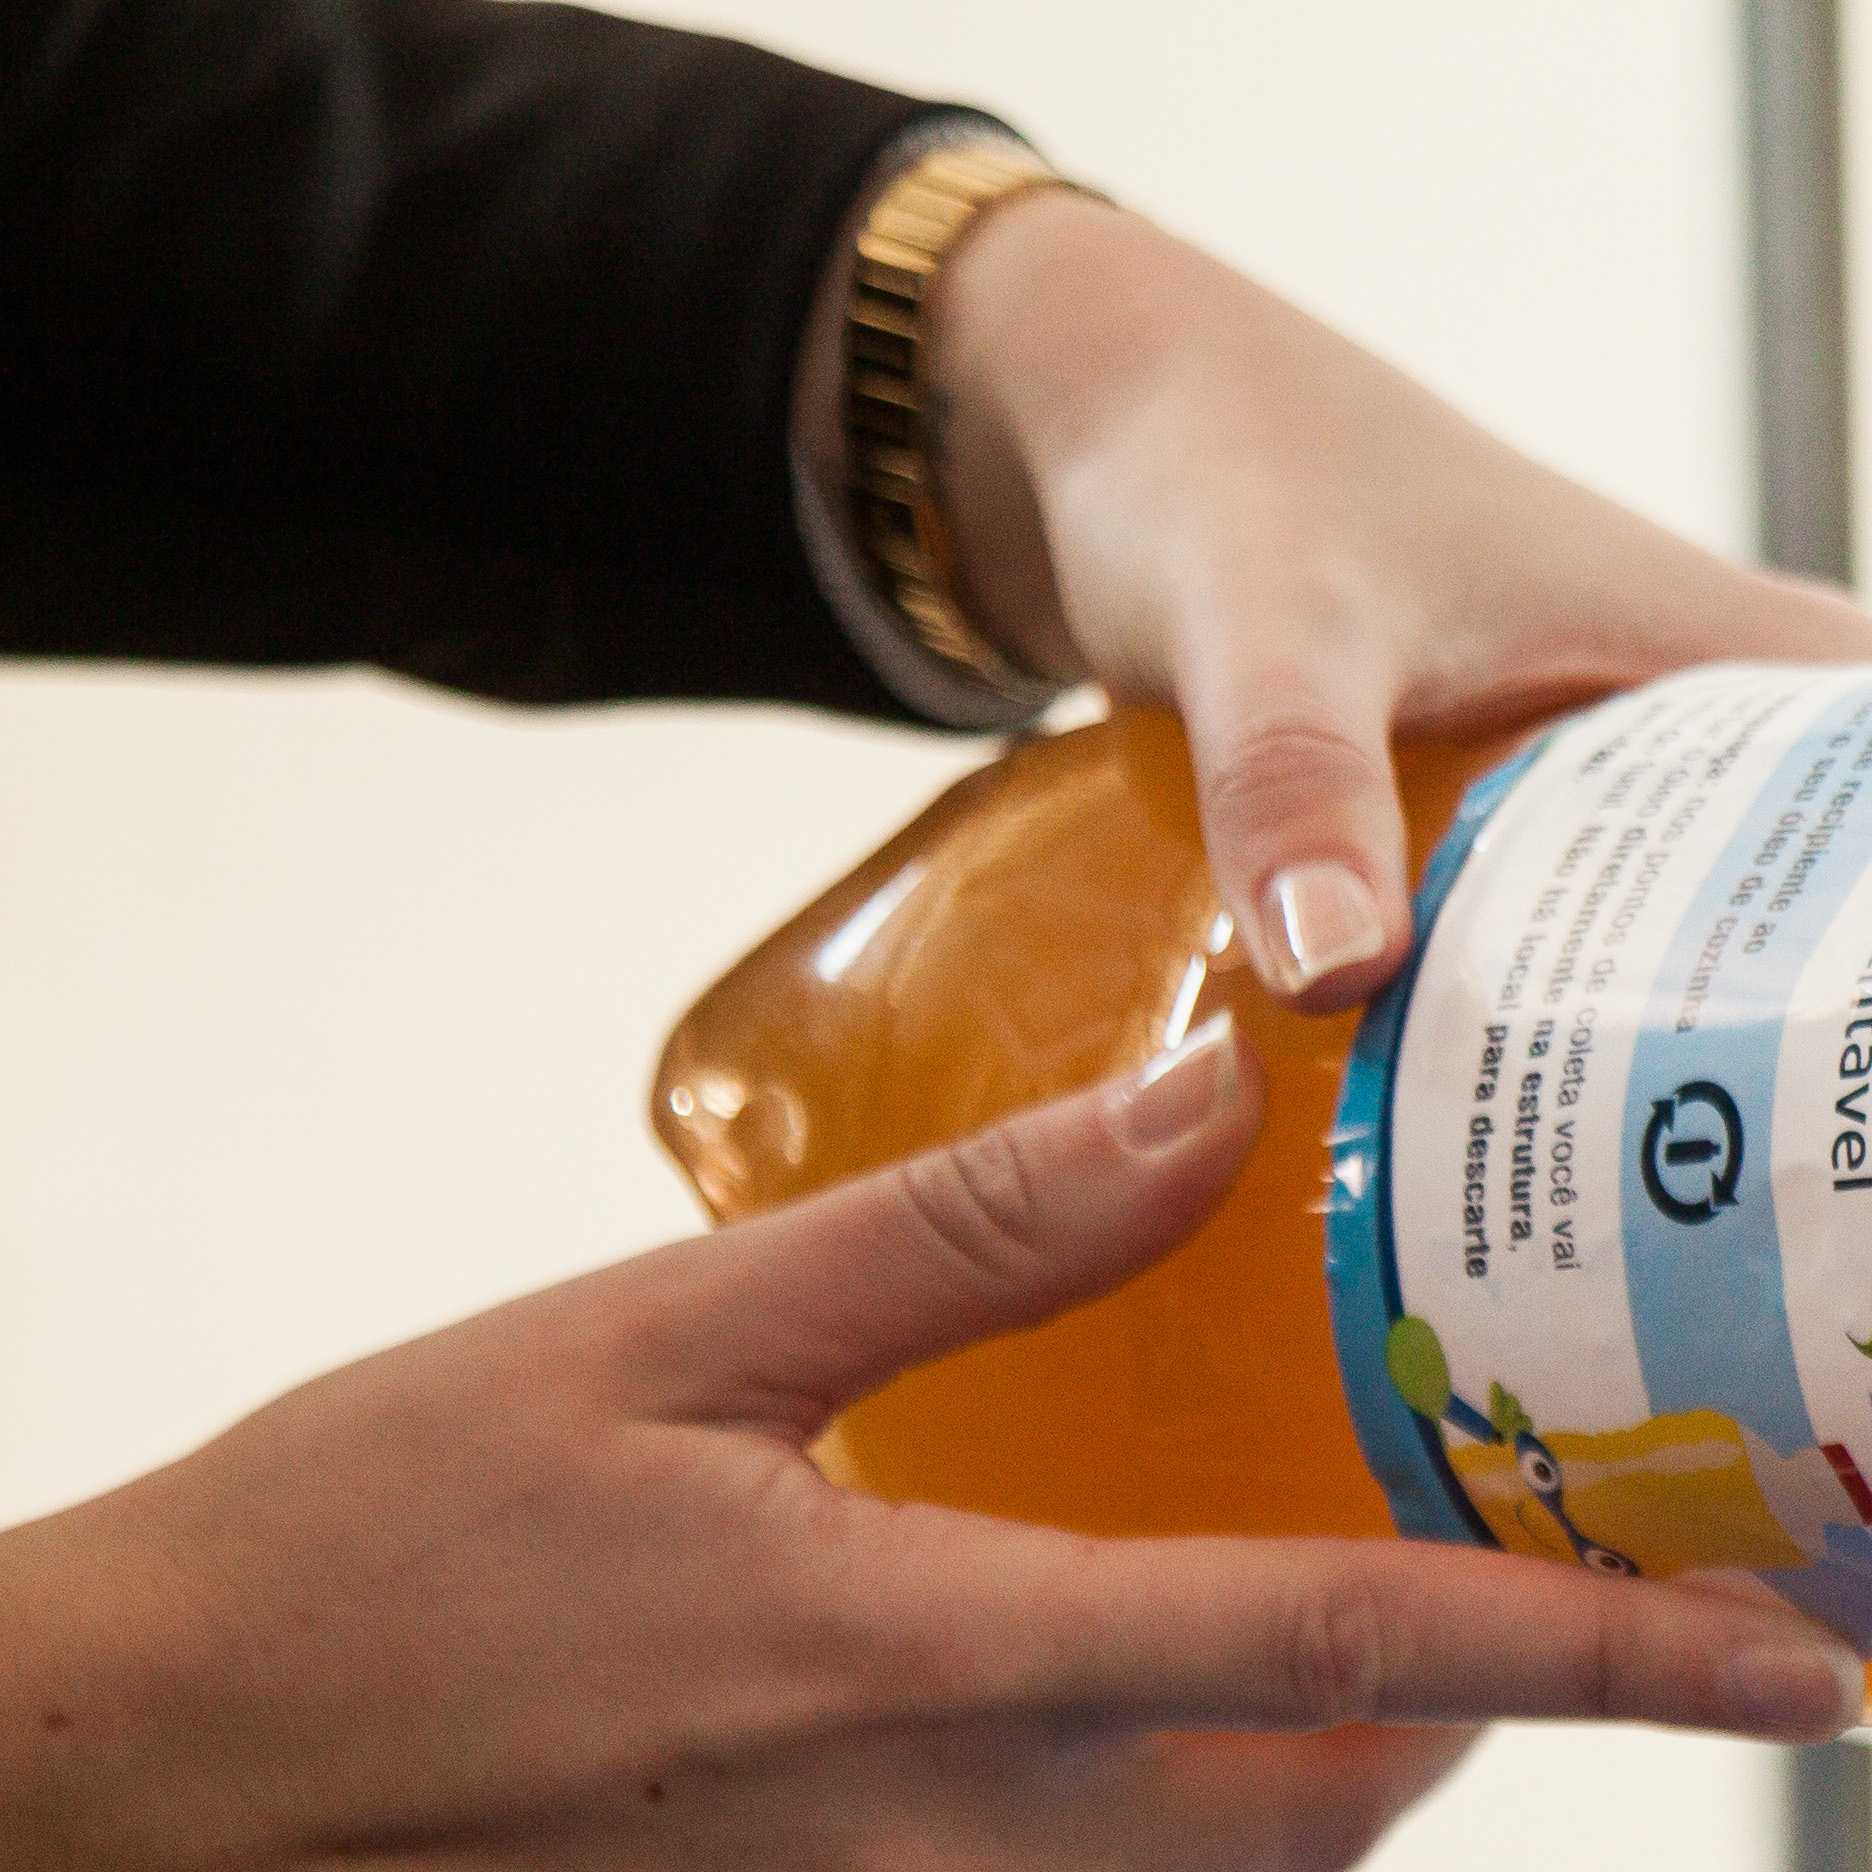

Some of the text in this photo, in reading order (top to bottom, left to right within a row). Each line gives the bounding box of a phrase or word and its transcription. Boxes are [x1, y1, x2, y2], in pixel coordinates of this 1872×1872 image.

[1472, 1022, 1510, 1104] para
[1528, 1017, 1558, 1061] na
[1556, 1005, 1598, 1110] coleta
[1462, 1112, 1497, 1280] descarte
[1506, 1069, 1544, 1254] estrutura,
[1549, 1118, 1580, 1207] você
[1551, 1218, 1583, 1273] vai
